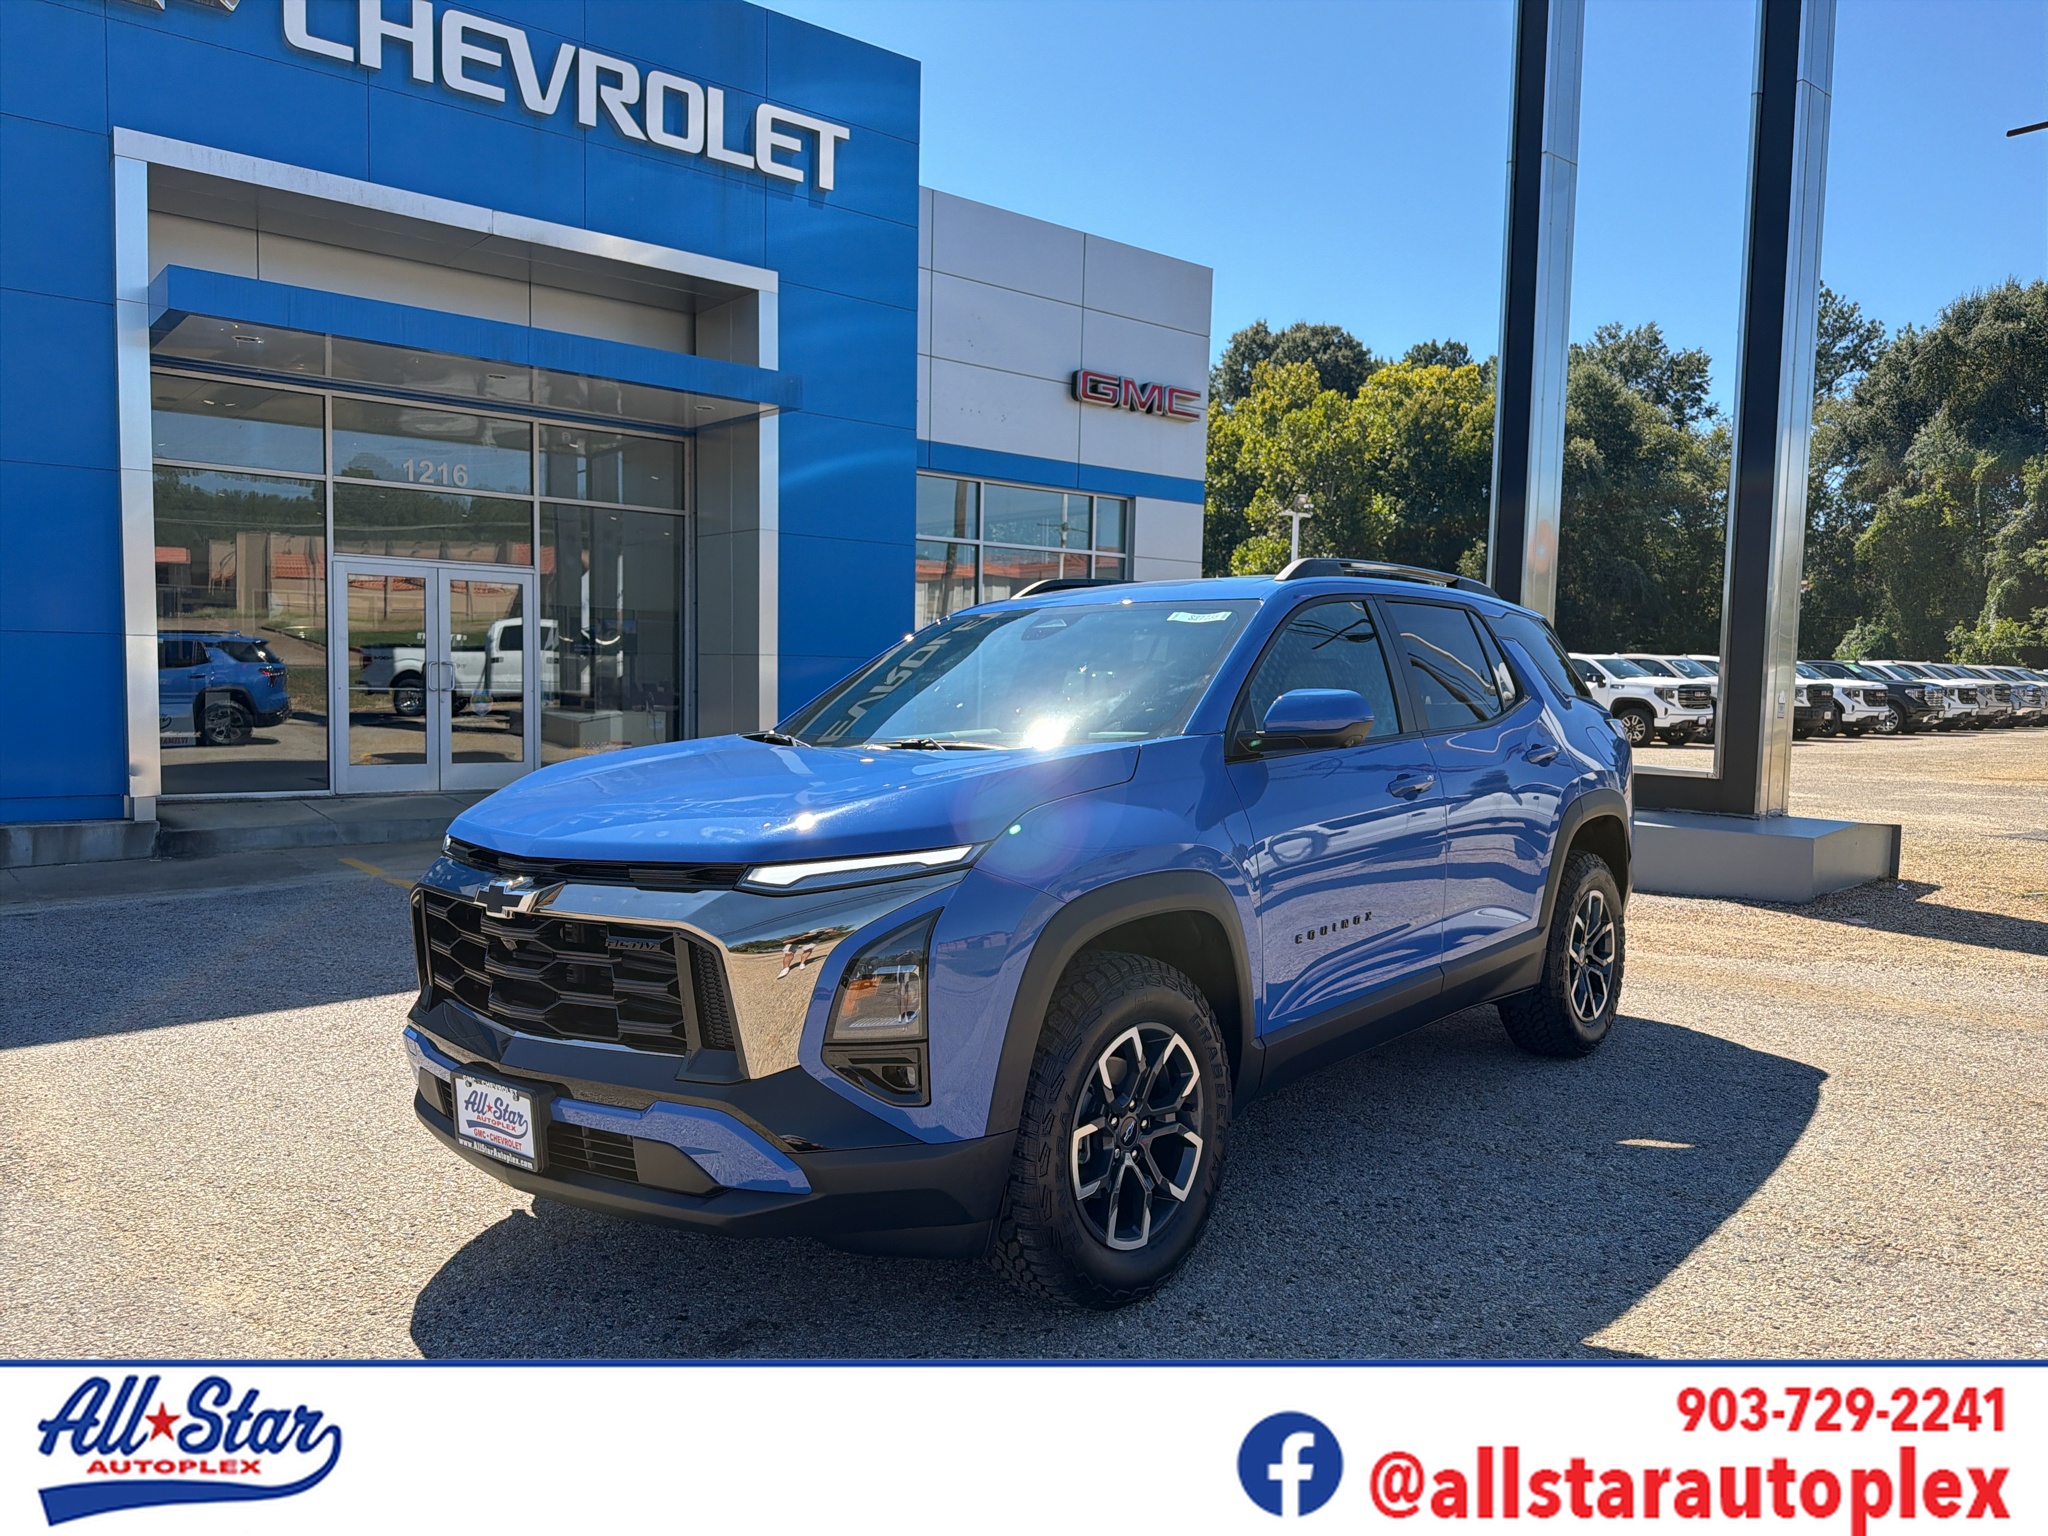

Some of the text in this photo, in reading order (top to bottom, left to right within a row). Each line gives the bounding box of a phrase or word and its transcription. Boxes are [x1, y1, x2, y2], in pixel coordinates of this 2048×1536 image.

[283, 0, 850, 191] CHEVROLET
[1072, 369, 1201, 421] GMC
[402, 458, 469, 487] 1216
[1295, 911, 1372, 944] EQUINOX
[464, 1090, 526, 1127] All Star
[476, 1114, 517, 1132] AUTOPLEX
